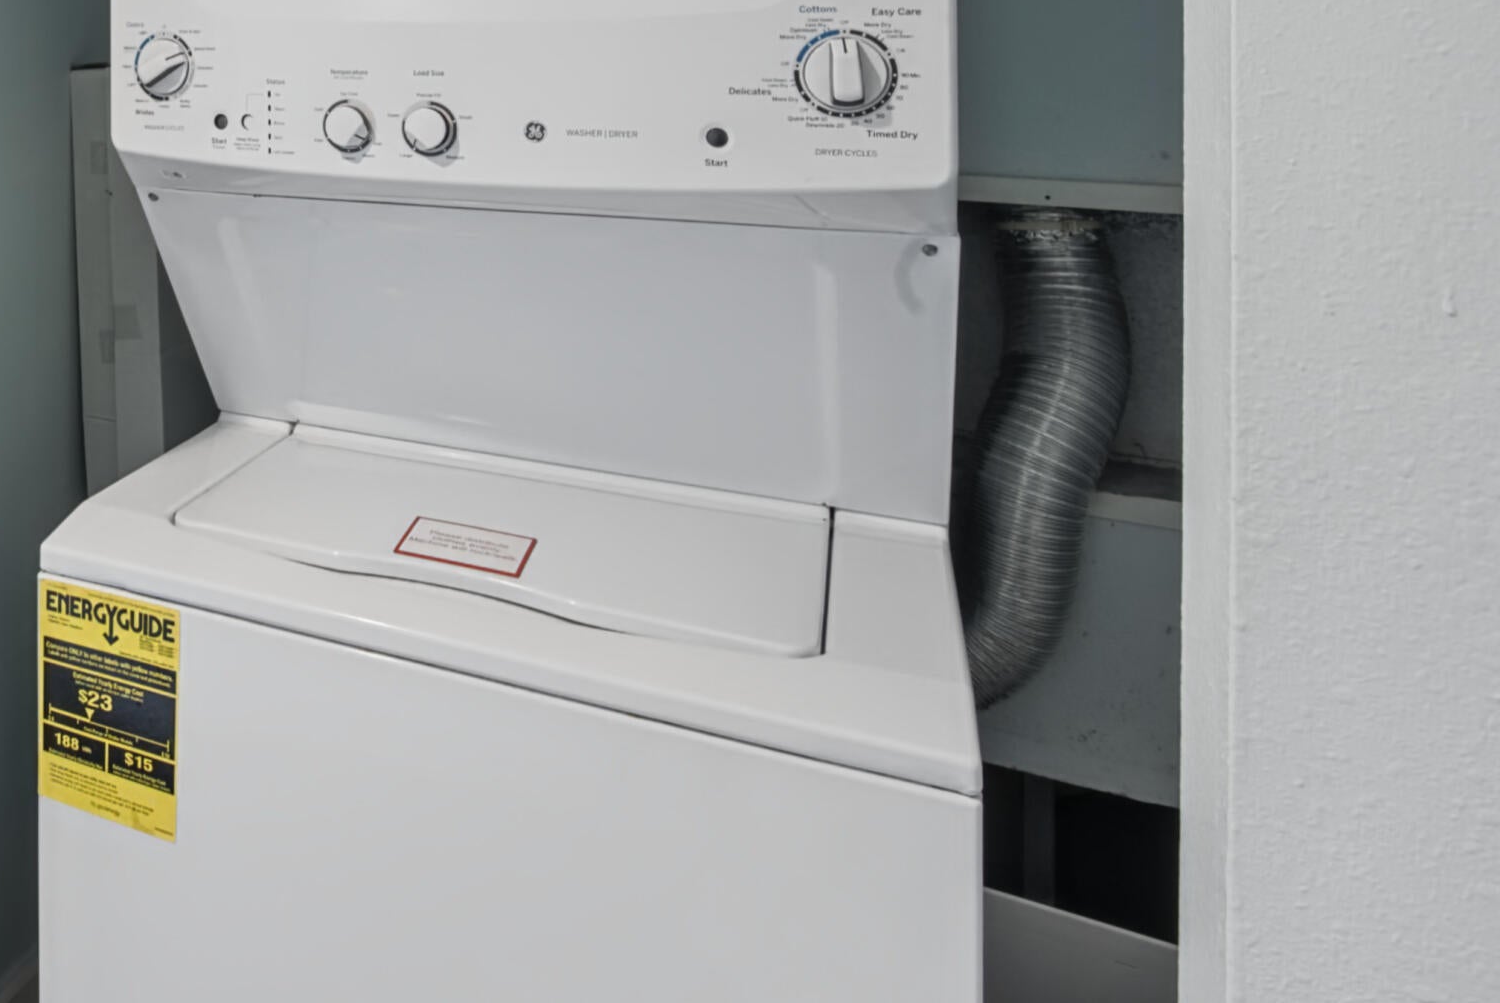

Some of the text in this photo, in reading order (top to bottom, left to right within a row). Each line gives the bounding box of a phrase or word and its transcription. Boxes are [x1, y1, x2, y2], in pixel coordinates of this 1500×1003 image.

[799, 5, 838, 14] Cottons
[871, 7, 922, 17] Easy Care
[413, 69, 430, 77] Load
[728, 87, 772, 96] Delicates
[566, 129, 639, 139] WASHER DRYER
[866, 130, 919, 141] Timed Dry
[814, 148, 878, 158] DRYER CYCLES
[704, 158, 729, 168] Start
[46, 589, 176, 644] ENERGYGUIDE
[77, 688, 114, 712] $23
[54, 731, 79, 751] 188
[124, 751, 154, 773] $15
